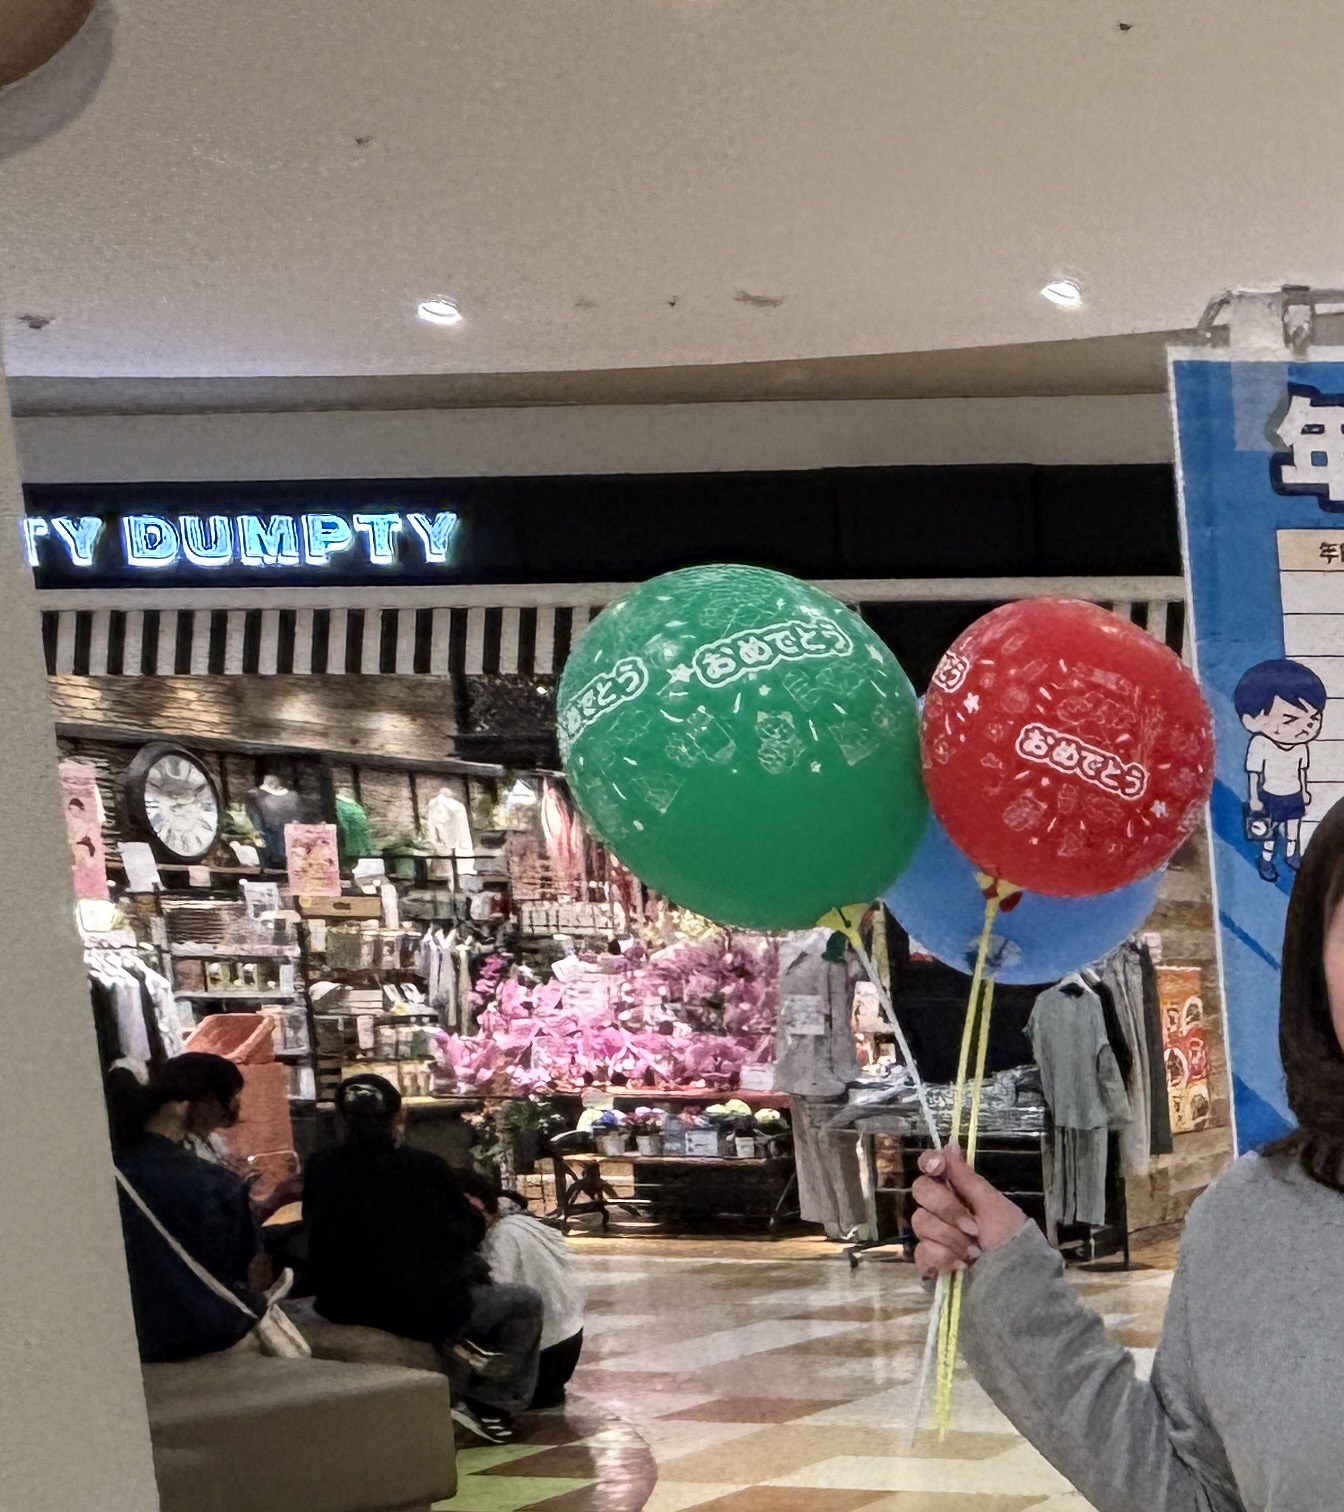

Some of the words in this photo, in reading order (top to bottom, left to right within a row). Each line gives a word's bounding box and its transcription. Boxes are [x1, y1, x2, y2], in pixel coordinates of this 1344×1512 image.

[122, 513, 460, 566] DUMPTY
[701, 616, 848, 680] おめでとう
[1021, 727, 1144, 797] おめでとう
